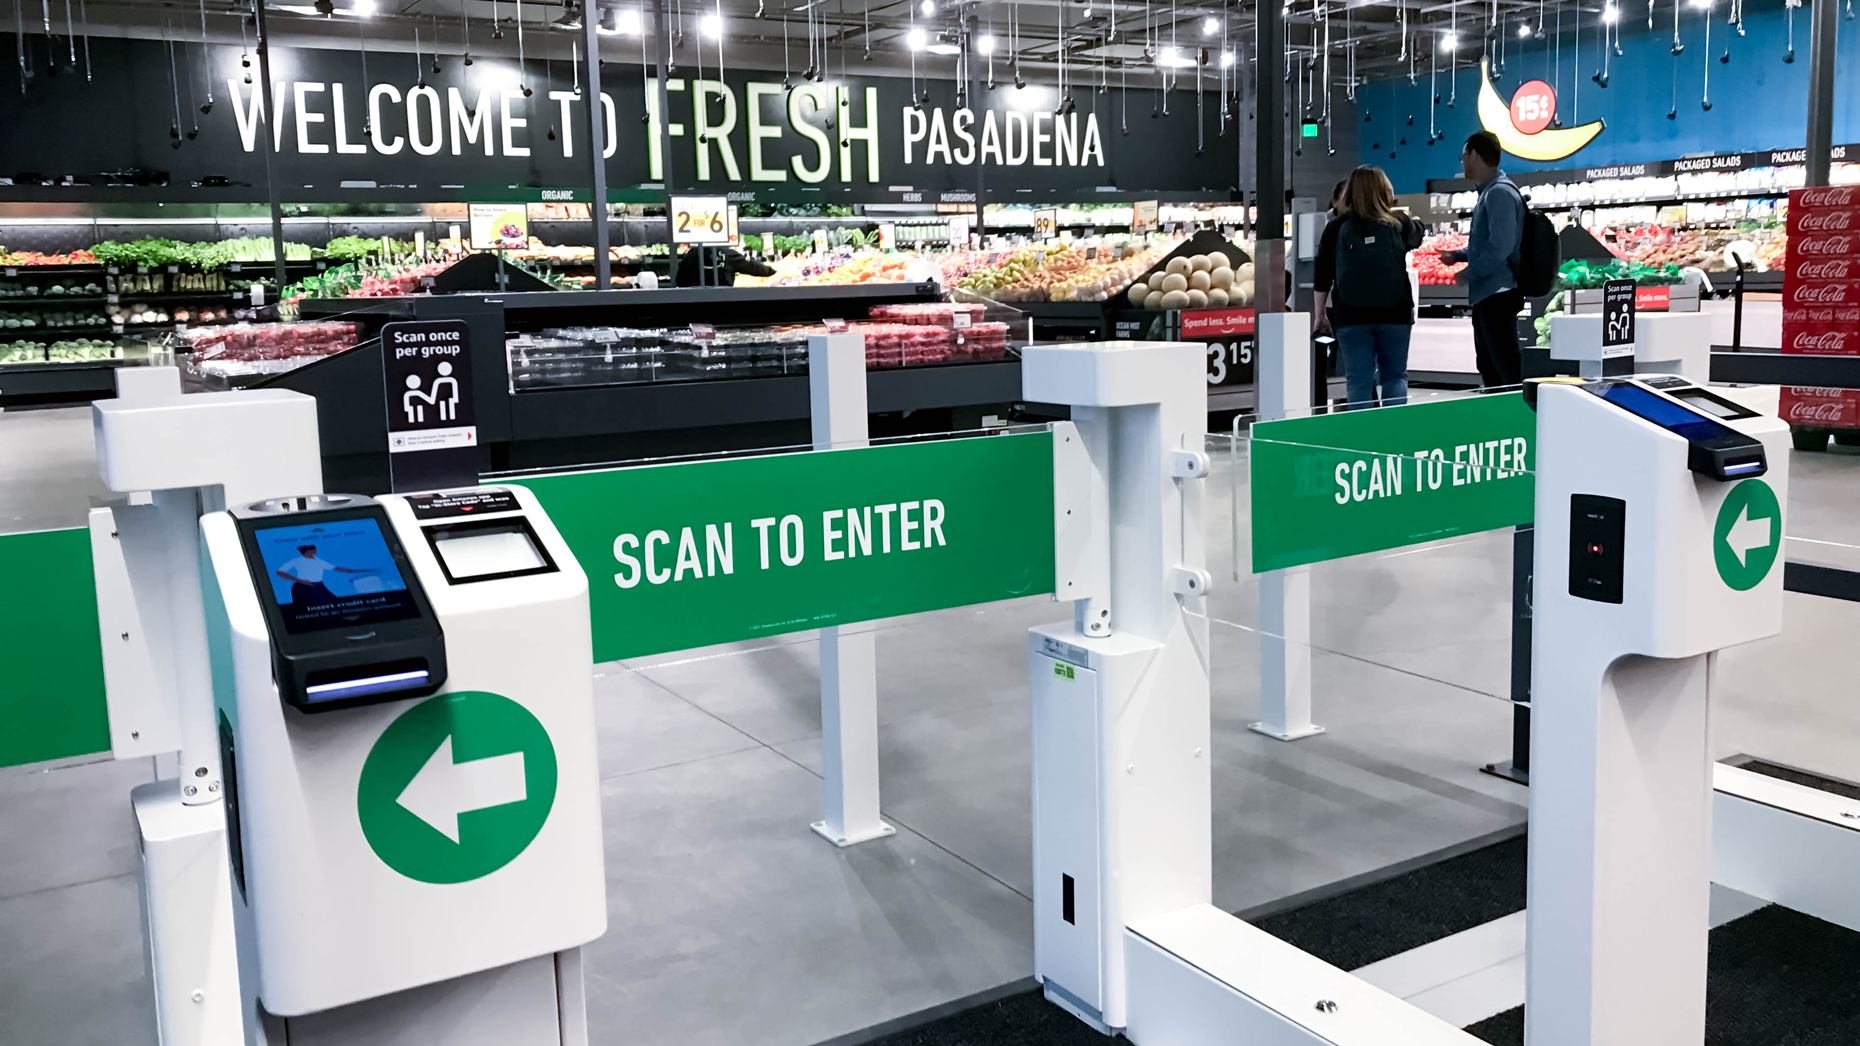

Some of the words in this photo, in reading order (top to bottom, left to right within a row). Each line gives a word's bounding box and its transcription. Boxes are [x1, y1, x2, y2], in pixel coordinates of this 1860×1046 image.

[227, 79, 531, 158] WELCOME
[647, 77, 879, 183] FRESH
[903, 106, 1104, 167] PASADENA
[1674, 158, 1710, 171] PACKAGED
[1712, 156, 1741, 168] SALADS
[1772, 150, 1806, 163] PACKAGE
[1586, 169, 1618, 179] PACKAGED
[1620, 165, 1644, 176] SALADS
[541, 190, 574, 200] ORGANIC
[727, 192, 756, 201] ORGANIC
[902, 193, 922, 202] HERBS
[940, 193, 976, 202] MUSHROOMS
[677, 210, 691, 233] 2
[693, 219, 706, 227] FOR
[1607, 294, 1616, 302] per
[1617, 293, 1633, 302] group
[1184, 317, 1208, 329] Spend
[1209, 316, 1225, 326] less.
[1226, 314, 1247, 325] Smile
[393, 331, 426, 343] Scan
[428, 331, 460, 341] once
[395, 346, 418, 359] per
[421, 344, 461, 358] group
[1207, 342, 1227, 384] 3
[1334, 453, 1404, 505] SCAN
[1414, 448, 1444, 492] TO
[1453, 437, 1527, 486] ENTER
[613, 522, 734, 589] SCAN
[751, 514, 805, 570] TO
[822, 499, 947, 562] ENTER
[307, 603, 334, 612] Insert
[366, 596, 386, 604] card
